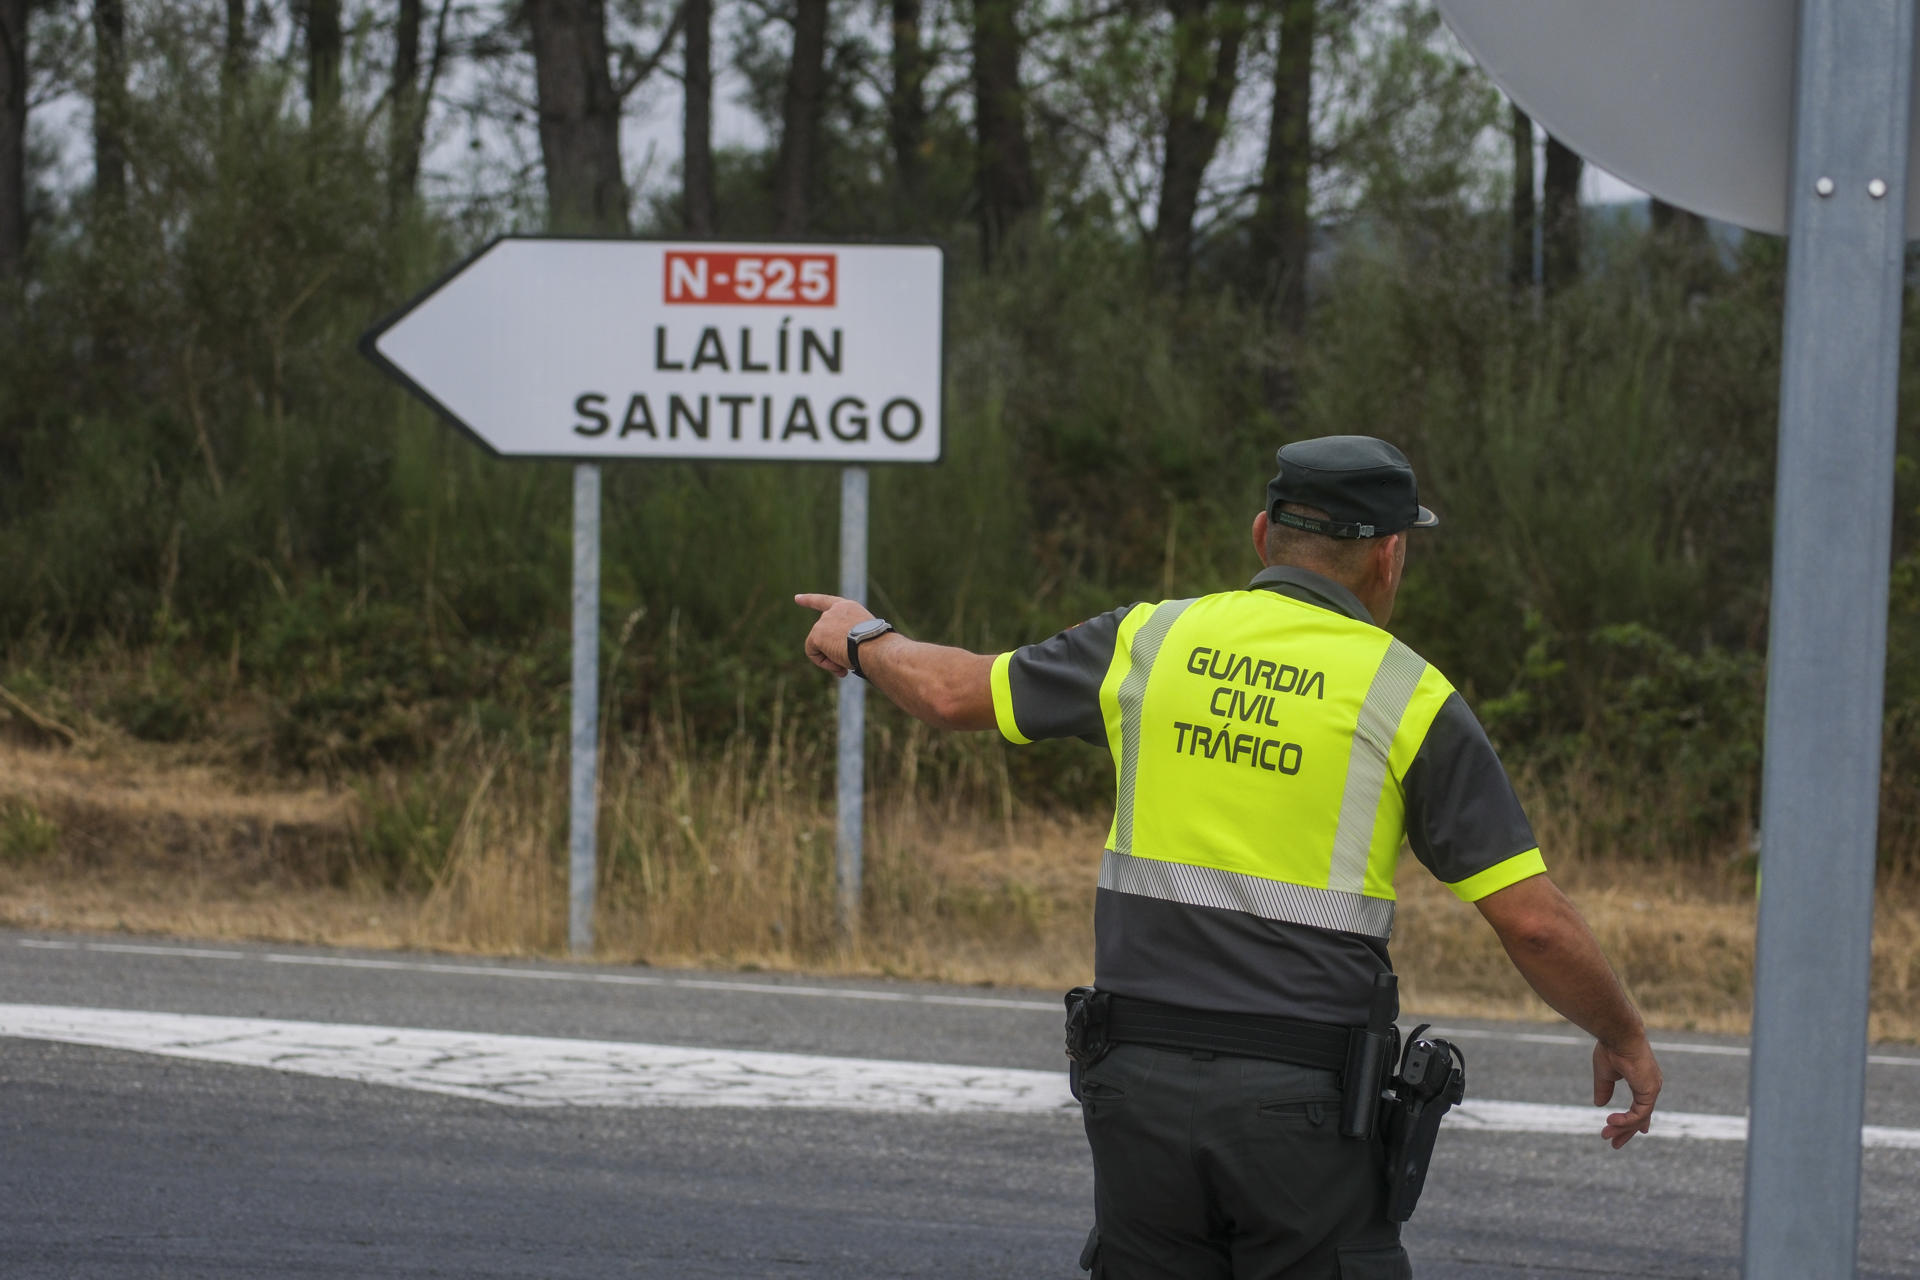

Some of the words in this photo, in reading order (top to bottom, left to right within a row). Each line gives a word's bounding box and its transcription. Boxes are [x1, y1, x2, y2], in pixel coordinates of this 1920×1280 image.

[671, 259, 830, 300] N-525
[655, 315, 843, 373] LALÍN
[573, 392, 923, 443] SANTIAGO
[1187, 647, 1325, 700] GUARDIA
[1210, 687, 1280, 728] CIVIL
[1174, 721, 1303, 776] TRÁFICO
